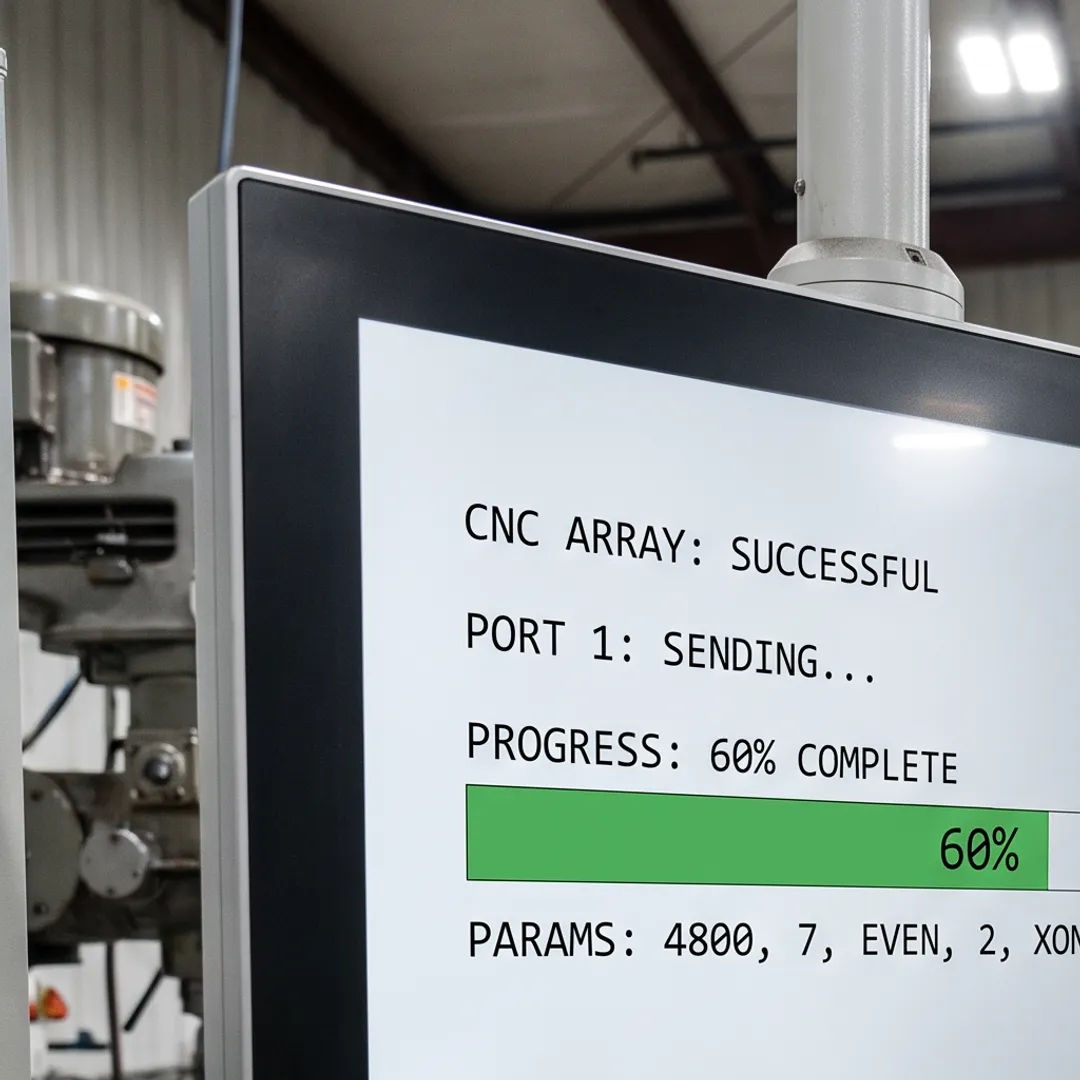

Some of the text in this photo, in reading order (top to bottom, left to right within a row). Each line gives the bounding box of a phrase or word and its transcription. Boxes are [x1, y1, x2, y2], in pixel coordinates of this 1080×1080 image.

[465, 503, 939, 594] CNC ARRAY: SUCCESSFUL
[467, 612, 874, 684] PORT 1: SENDING...
[468, 721, 957, 785] PROGRESS: 60% COMPLETE
[940, 825, 1020, 872] 60%
[470, 921, 633, 957] PARAMS:
[663, 922, 769, 964] 4800,
[798, 923, 832, 963] 7,
[863, 923, 953, 963] EVEN,
[979, 923, 1010, 963] 2,
